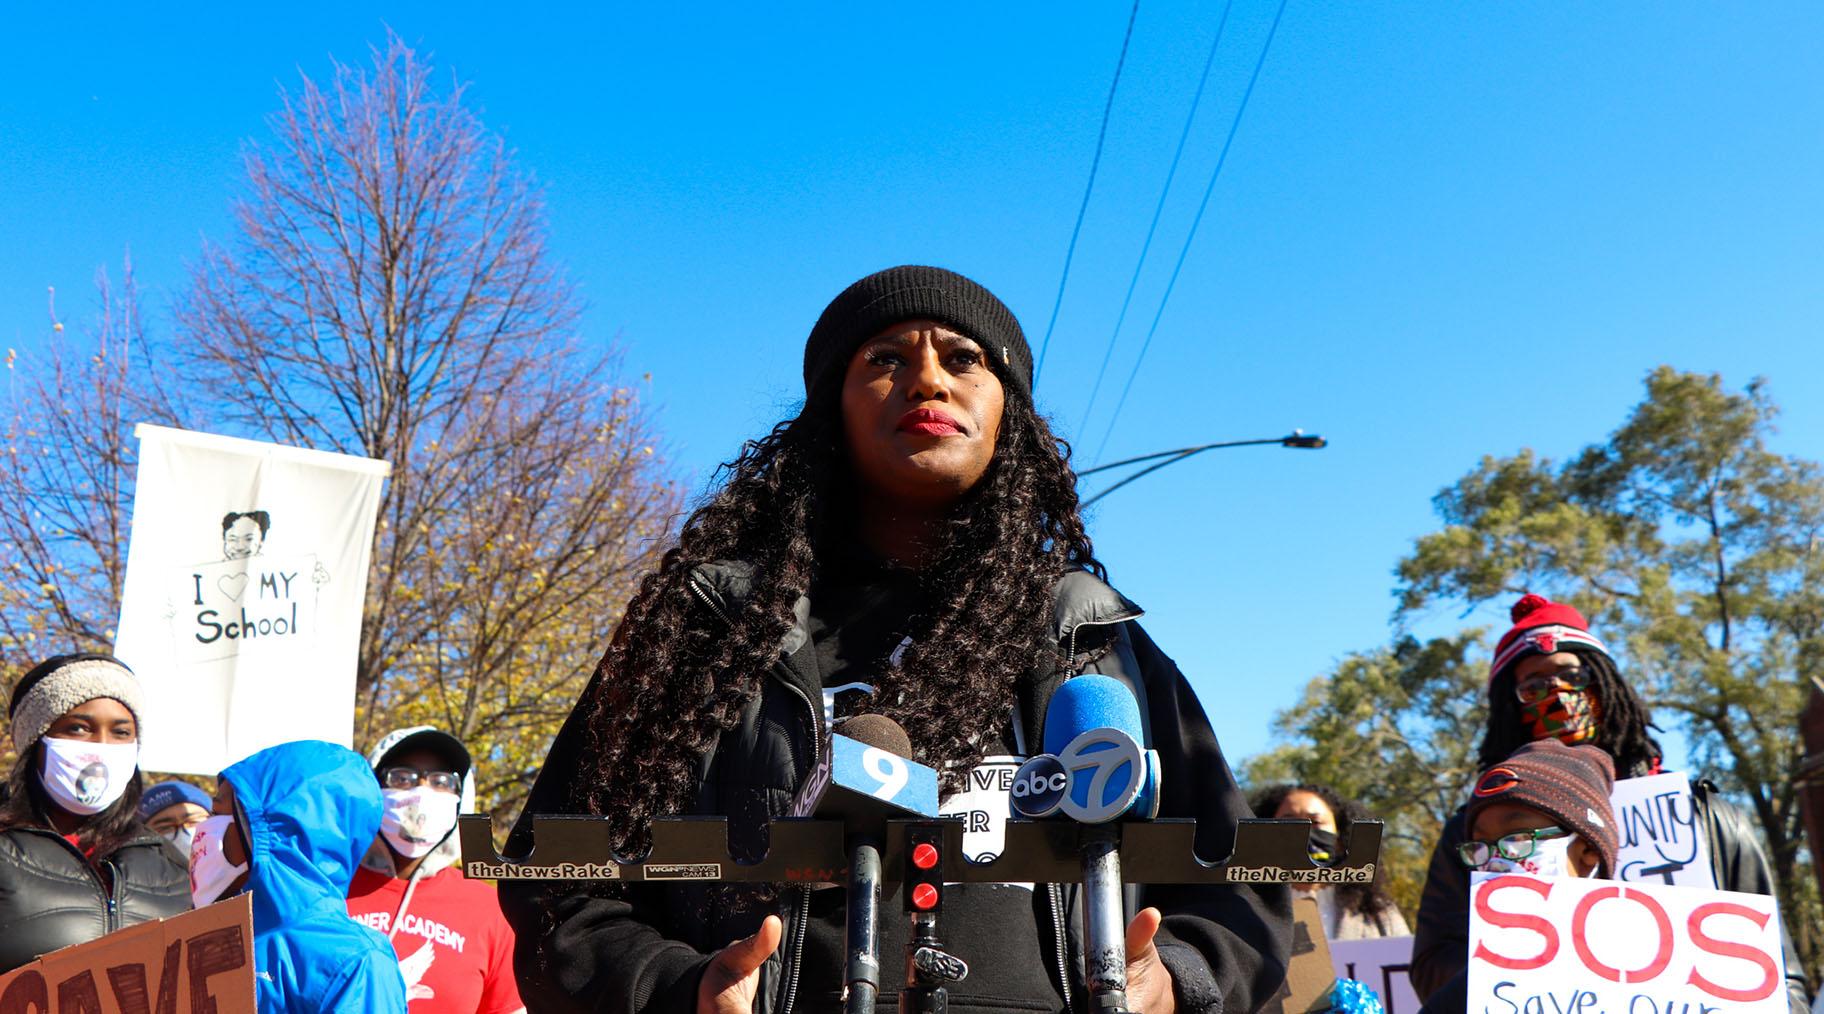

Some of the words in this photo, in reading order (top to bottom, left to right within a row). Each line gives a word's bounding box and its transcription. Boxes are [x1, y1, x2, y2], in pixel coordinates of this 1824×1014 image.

[193, 574, 204, 605] I
[260, 572, 298, 599] MY
[195, 602, 297, 644] School
[862, 747, 909, 801] 9
[1012, 771, 1067, 798] abc
[1064, 735, 1138, 818] 7
[396, 914, 466, 954] ACADEMY
[1472, 873, 1779, 1003] SOS
